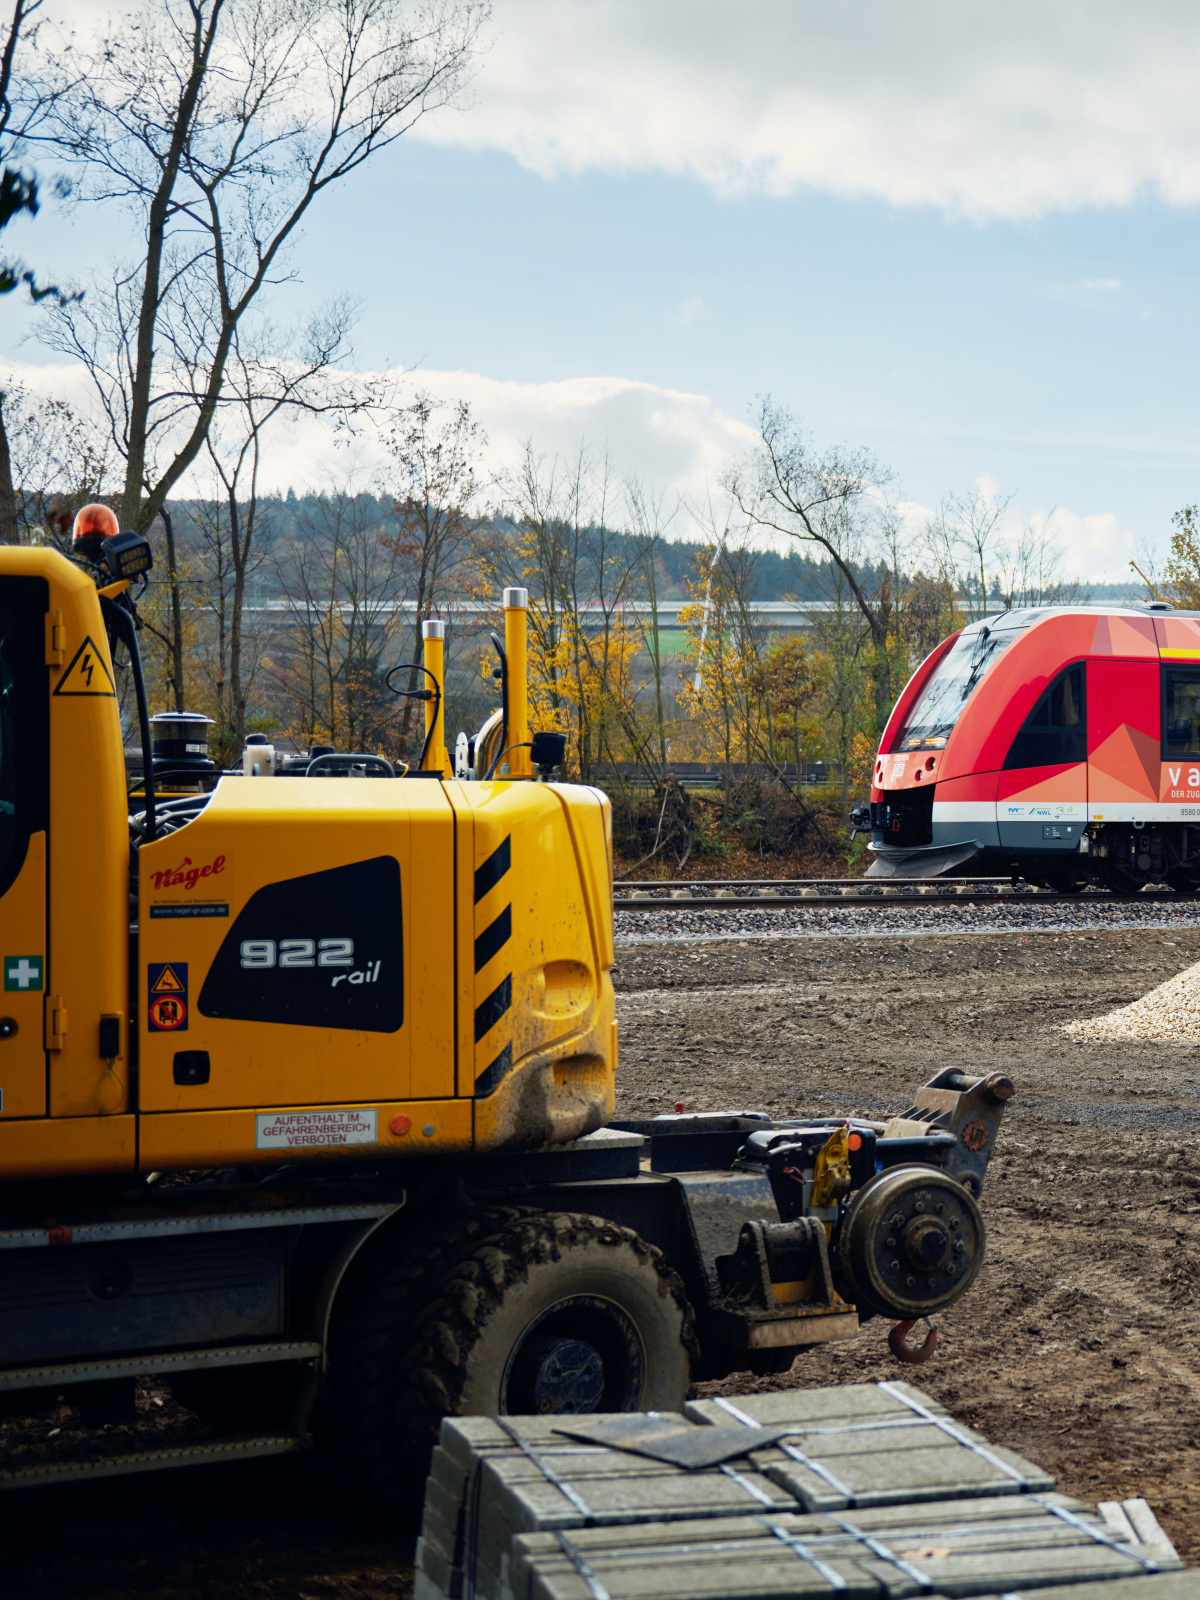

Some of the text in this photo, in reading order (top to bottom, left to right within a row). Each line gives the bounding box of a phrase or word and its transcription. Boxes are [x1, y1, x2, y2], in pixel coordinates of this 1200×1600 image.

[1171, 790, 1185, 798] DER
[1186, 790, 1200, 798] ZUG
[149, 854, 226, 890] Nagel
[153, 906, 226, 915] www.nagel-gruppe.de
[240, 938, 354, 968] 922
[331, 960, 381, 987] rail
[274, 1113, 360, 1125] AUFENTHALT IM
[262, 1123, 371, 1136] GEFAHRENBEREICH
[287, 1134, 347, 1145] VERBOTEN
